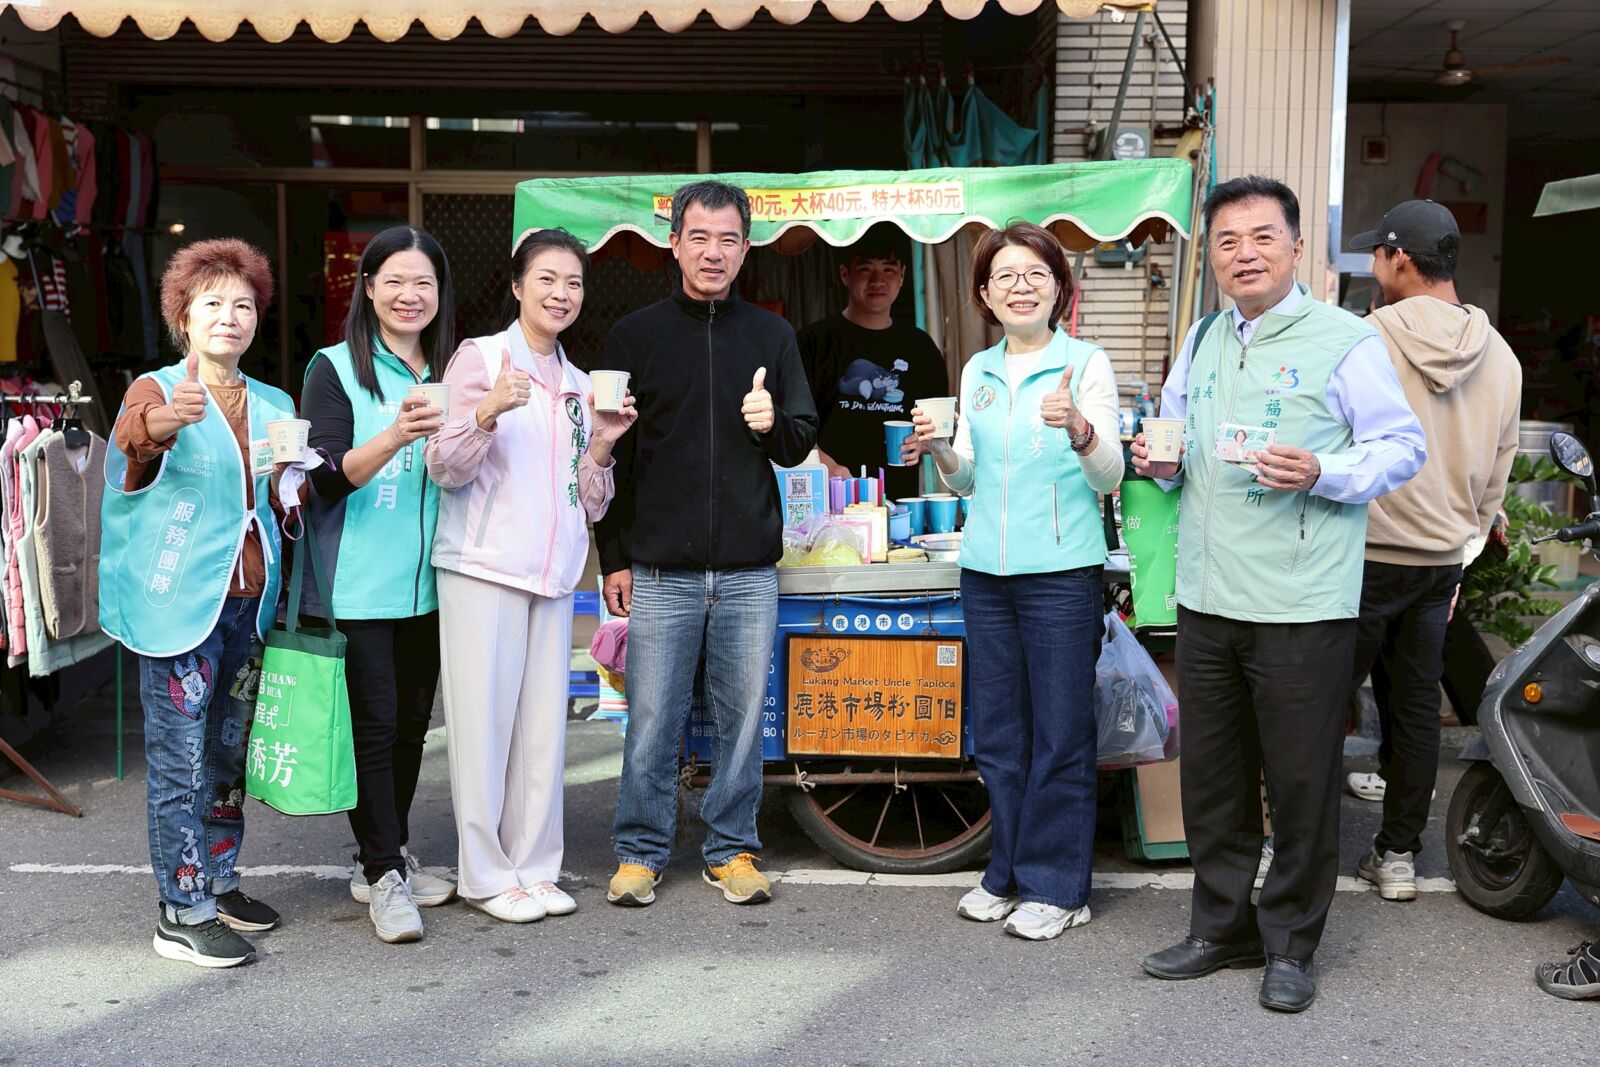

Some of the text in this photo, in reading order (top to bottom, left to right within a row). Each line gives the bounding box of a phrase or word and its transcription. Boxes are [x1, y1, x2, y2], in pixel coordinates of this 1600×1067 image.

[150, 501, 196, 594] 服務團隊
[834, 616, 912, 630] 鹿港市場
[267, 671, 297, 687] CHANG
[802, 676, 955, 688] Lukang Market Uncle Tapioca
[266, 685, 282, 699] HUA
[793, 690, 957, 723] 鹿港市場粉圓伯
[763, 712, 776, 722] 70
[763, 727, 777, 737] 80
